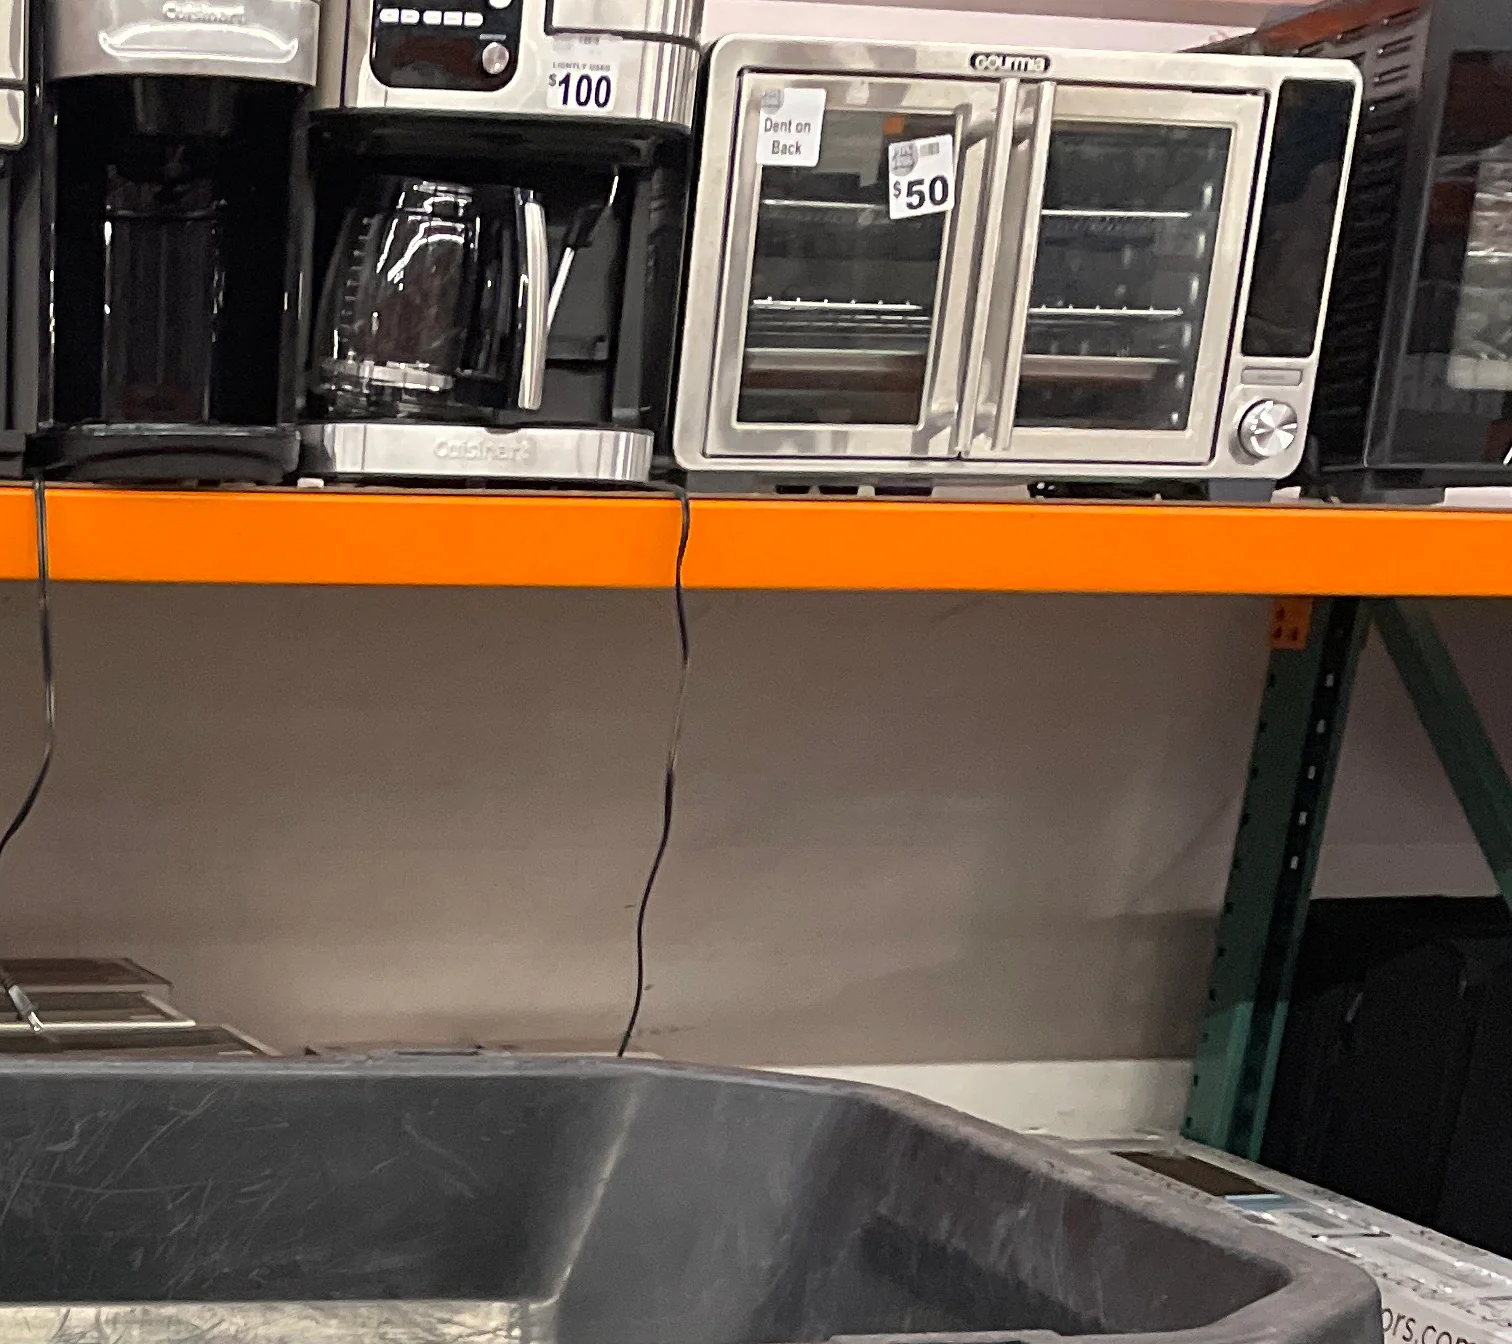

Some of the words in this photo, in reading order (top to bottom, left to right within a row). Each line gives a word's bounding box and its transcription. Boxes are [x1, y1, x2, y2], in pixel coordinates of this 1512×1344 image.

[548, 72, 612, 109] $100
[764, 117, 792, 133] Dent
[795, 122, 811, 133] on
[771, 140, 802, 155] Back
[893, 174, 949, 210] $50
